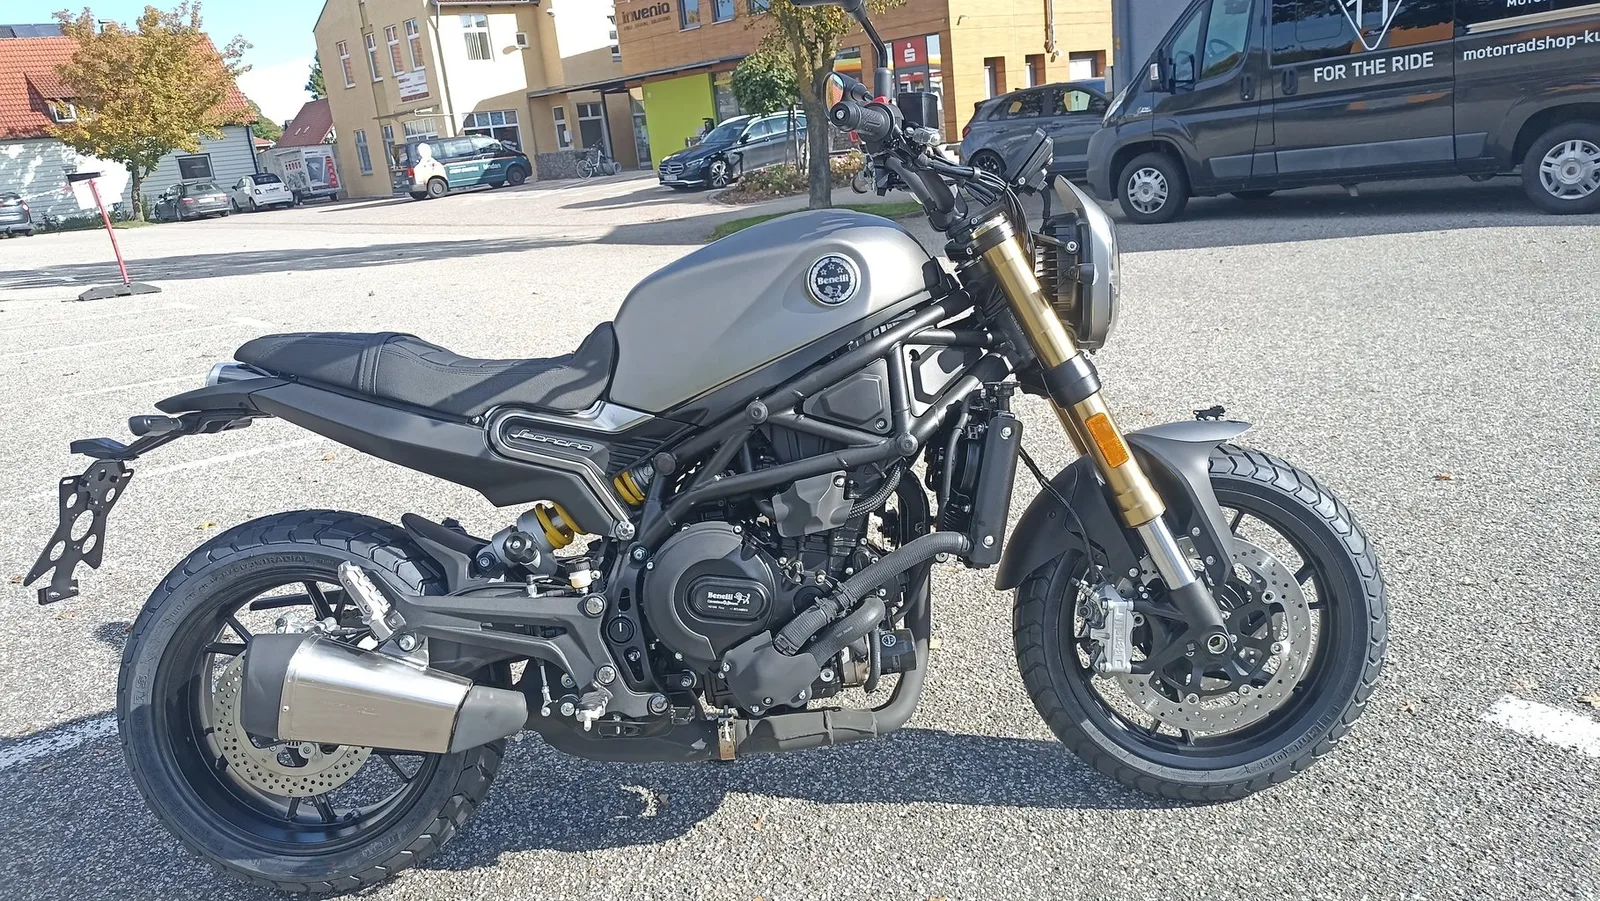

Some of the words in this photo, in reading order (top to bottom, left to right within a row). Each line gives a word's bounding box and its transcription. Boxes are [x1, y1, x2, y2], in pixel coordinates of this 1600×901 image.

[621, 2, 671, 24] invenio
[1313, 64, 1347, 83] FOR
[1352, 58, 1386, 77] THE
[1392, 51, 1434, 72] RIDE
[817, 273, 849, 285] Benelli
[707, 591, 733, 600] Benelli
